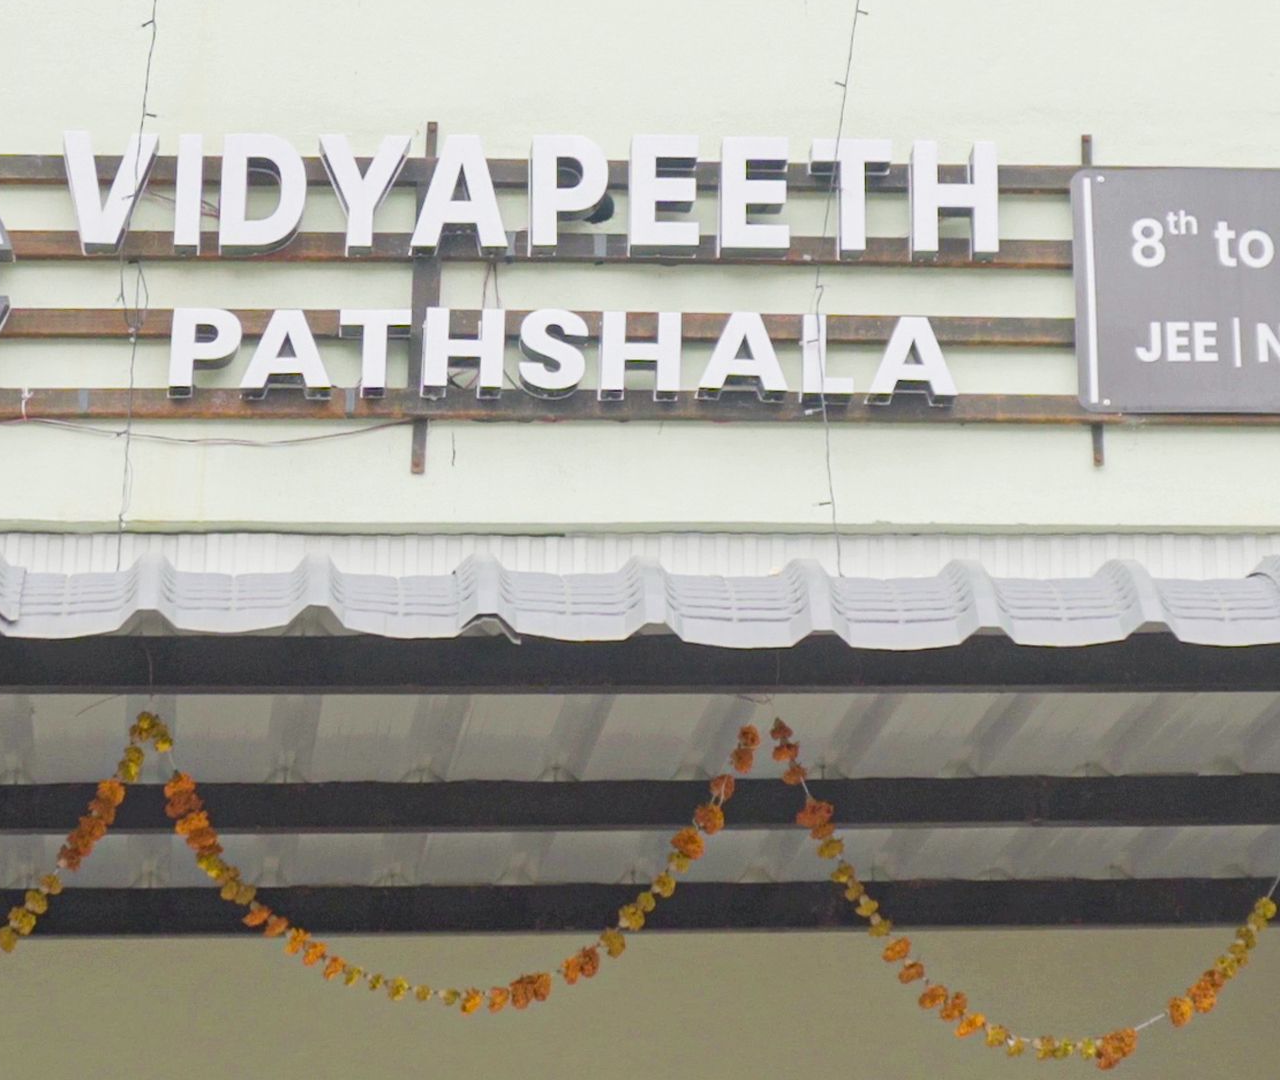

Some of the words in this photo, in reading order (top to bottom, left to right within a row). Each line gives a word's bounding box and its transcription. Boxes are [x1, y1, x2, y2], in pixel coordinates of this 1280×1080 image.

[63, 130, 1000, 262] VIDYAPEETH
[1131, 210, 1198, 268] 8th
[1215, 221, 1275, 269] to
[167, 307, 959, 407] PATHSHALA
[1135, 321, 1219, 363] JEE
